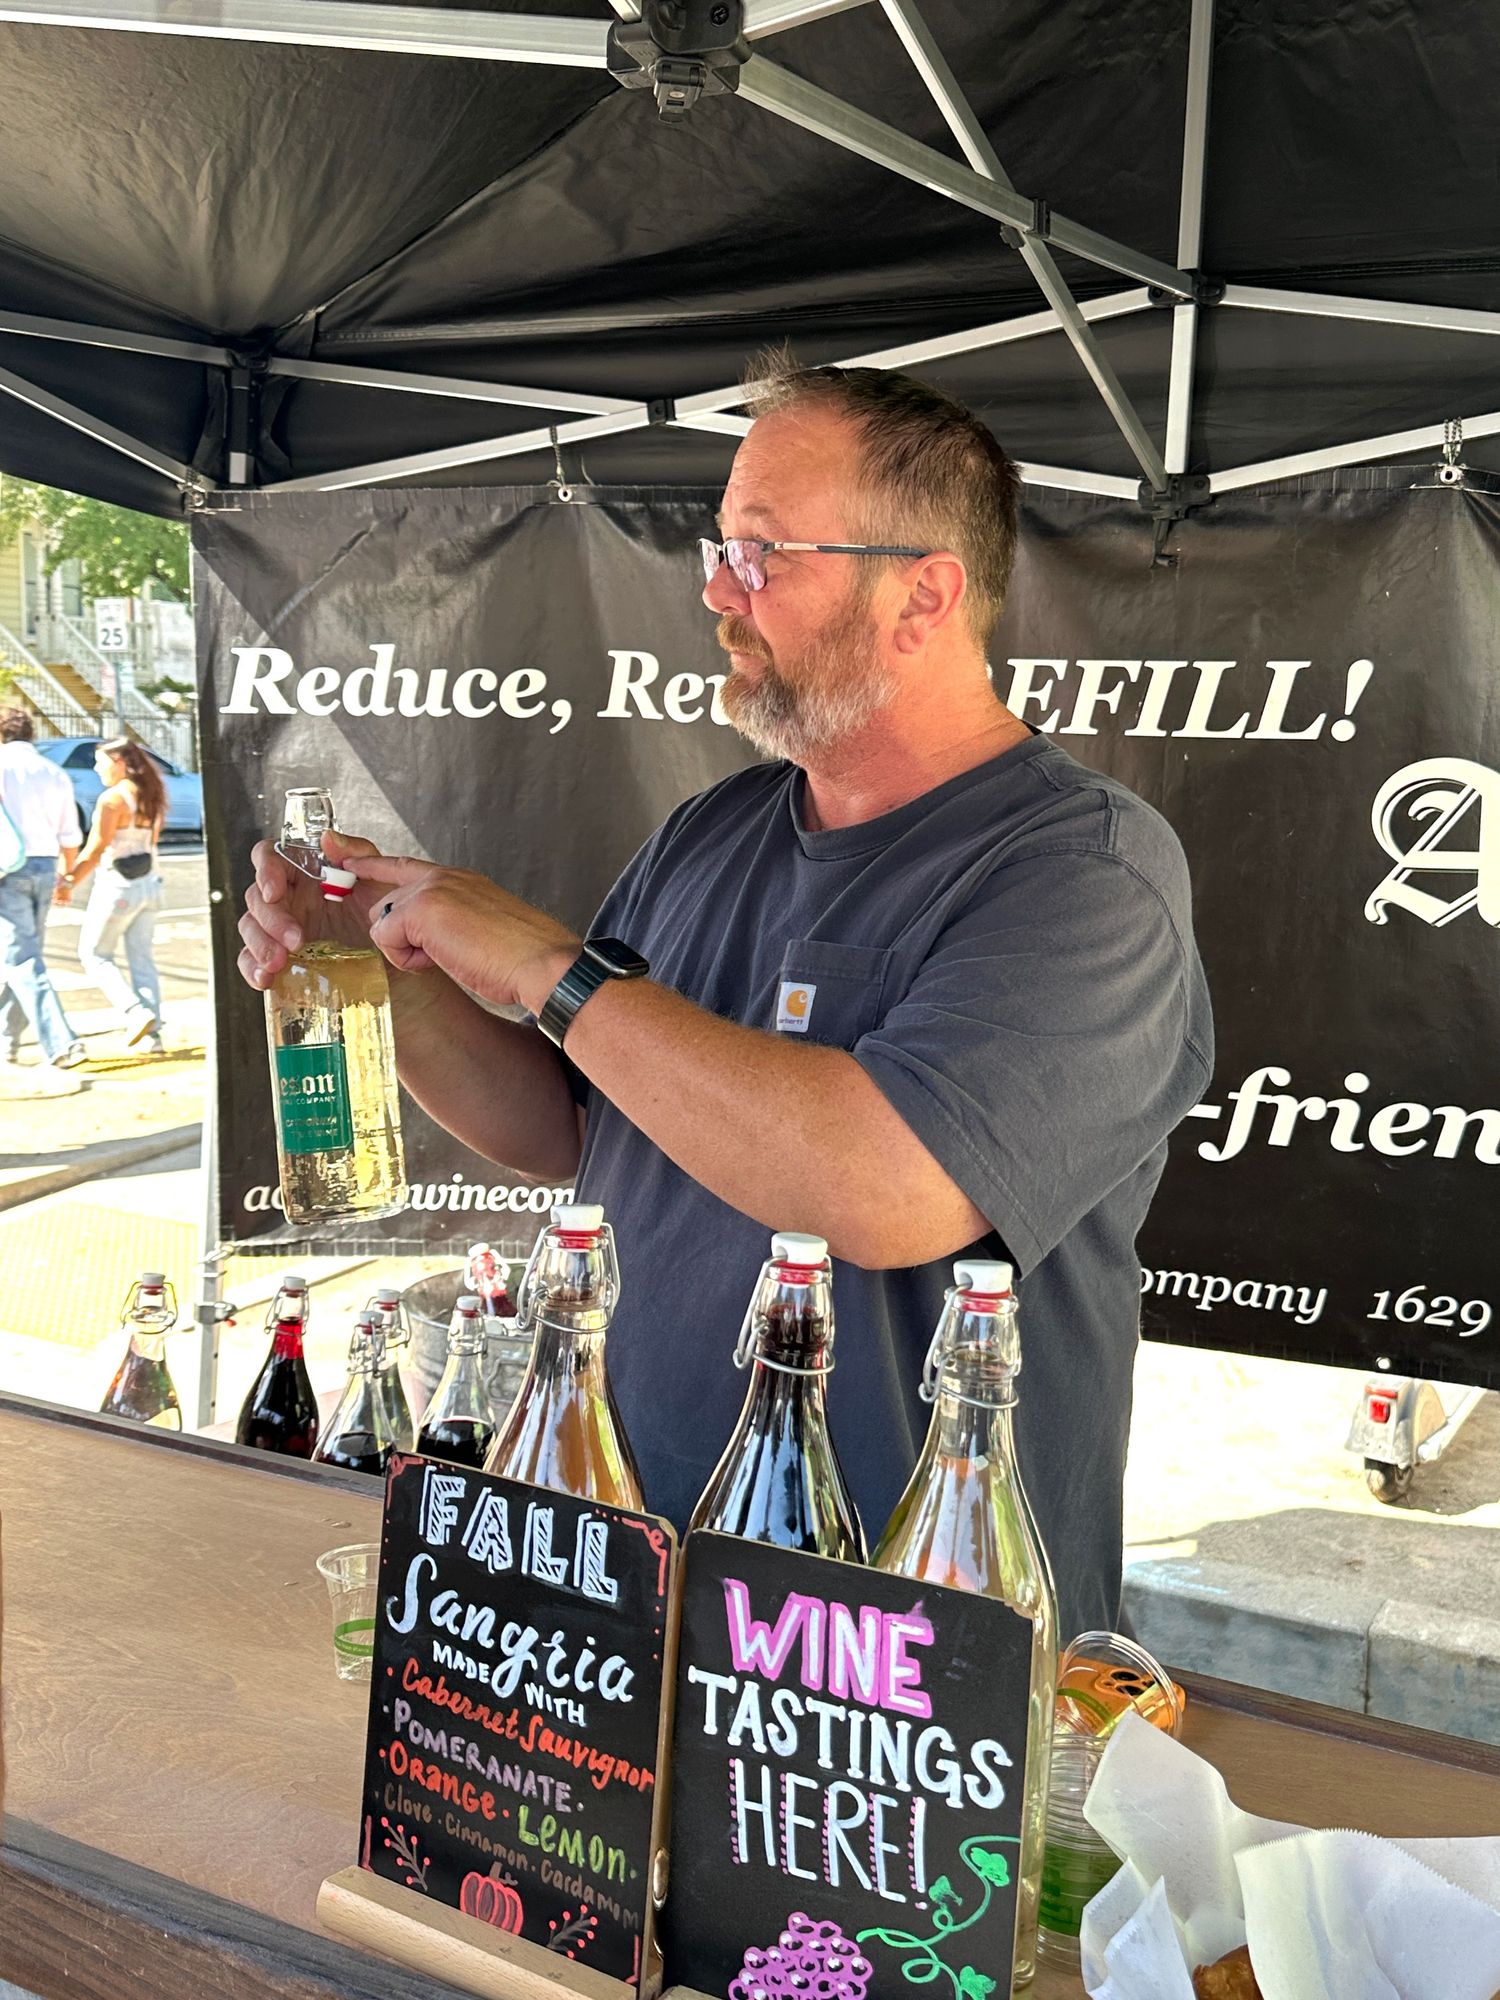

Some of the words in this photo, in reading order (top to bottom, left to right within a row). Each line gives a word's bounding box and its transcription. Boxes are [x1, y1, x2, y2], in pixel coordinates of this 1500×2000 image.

[101, 628, 123, 646] 25
[219, 643, 573, 735] Reduce,
[988, 658, 1375, 743] EFILL!
[1364, 757, 1500, 928] A
[1185, 1066, 1500, 1165] -frien
[1139, 1267, 1328, 1325] ompany
[1367, 1285, 1492, 1337] 1629
[418, 1465, 618, 1603] FALL
[386, 1553, 634, 1702] Sangria
[724, 1578, 935, 1719] WINE
[402, 1657, 519, 1740] Cabernet
[433, 1640, 490, 1683] MADE
[524, 1682, 587, 1727] WITH
[688, 1665, 1014, 1810] TASTINGS
[384, 1782, 432, 1824] Clove
[445, 1811, 528, 1872] Cinnamon
[728, 1757, 928, 1910] HERE!
